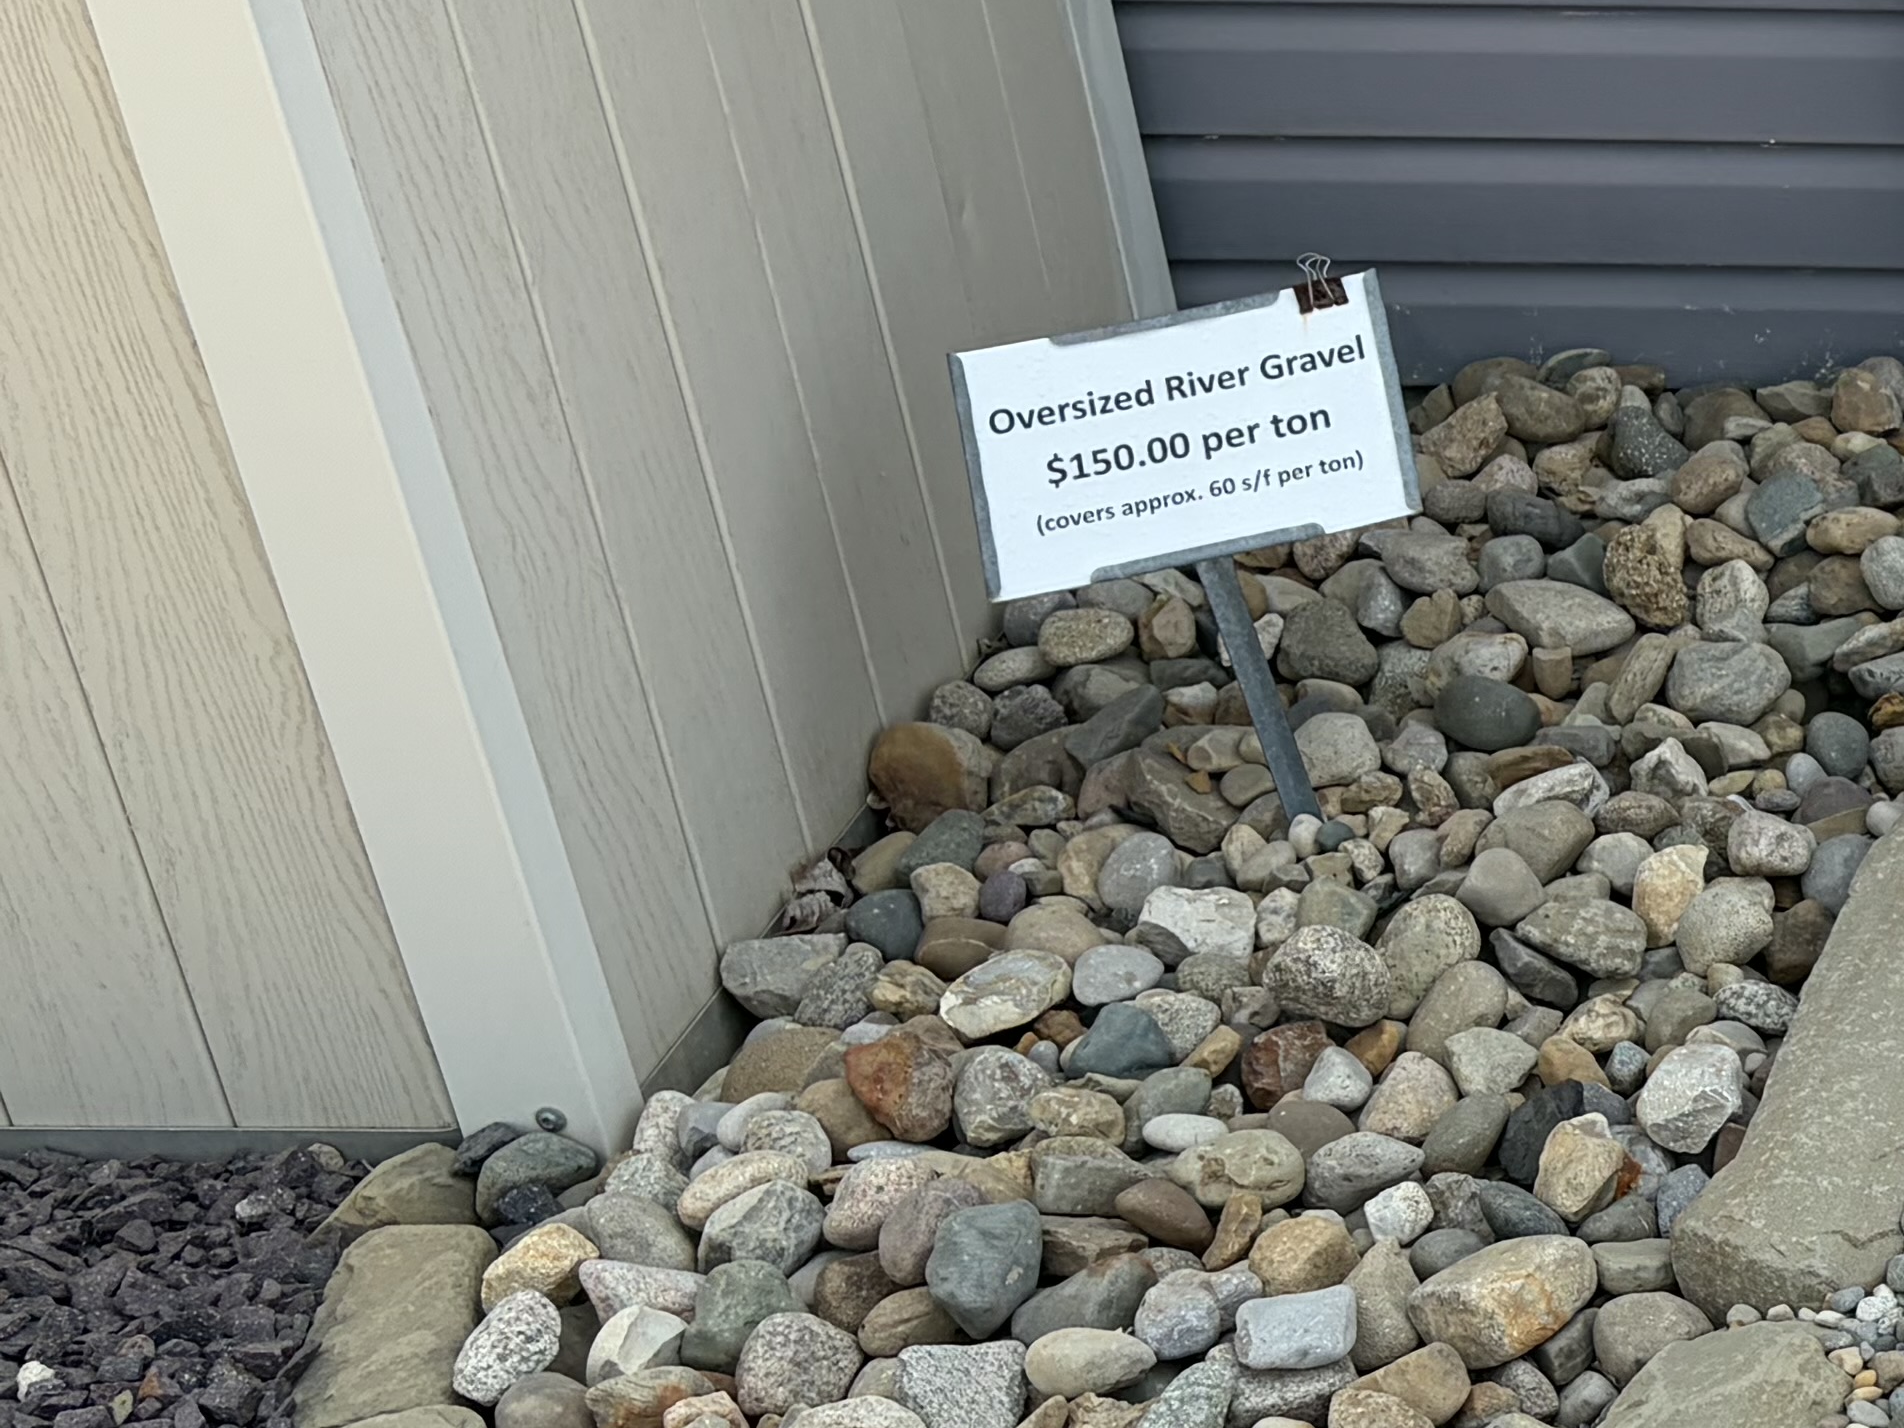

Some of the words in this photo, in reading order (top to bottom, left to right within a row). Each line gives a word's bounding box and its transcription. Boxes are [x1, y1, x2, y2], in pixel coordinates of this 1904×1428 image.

[988, 379, 1155, 435] Oversized
[1164, 366, 1250, 402] River
[1259, 334, 1365, 380] Gravel
[1036, 506, 1116, 537] (covers
[1121, 488, 1203, 518] approx.
[1209, 477, 1236, 498] 60
[1241, 468, 1271, 493] s/f
[1277, 464, 1313, 488] per
[1318, 449, 1364, 475] ton)
[1046, 432, 1190, 489] $150.00
[1201, 422, 1261, 461] per
[1269, 409, 1331, 439] ton
